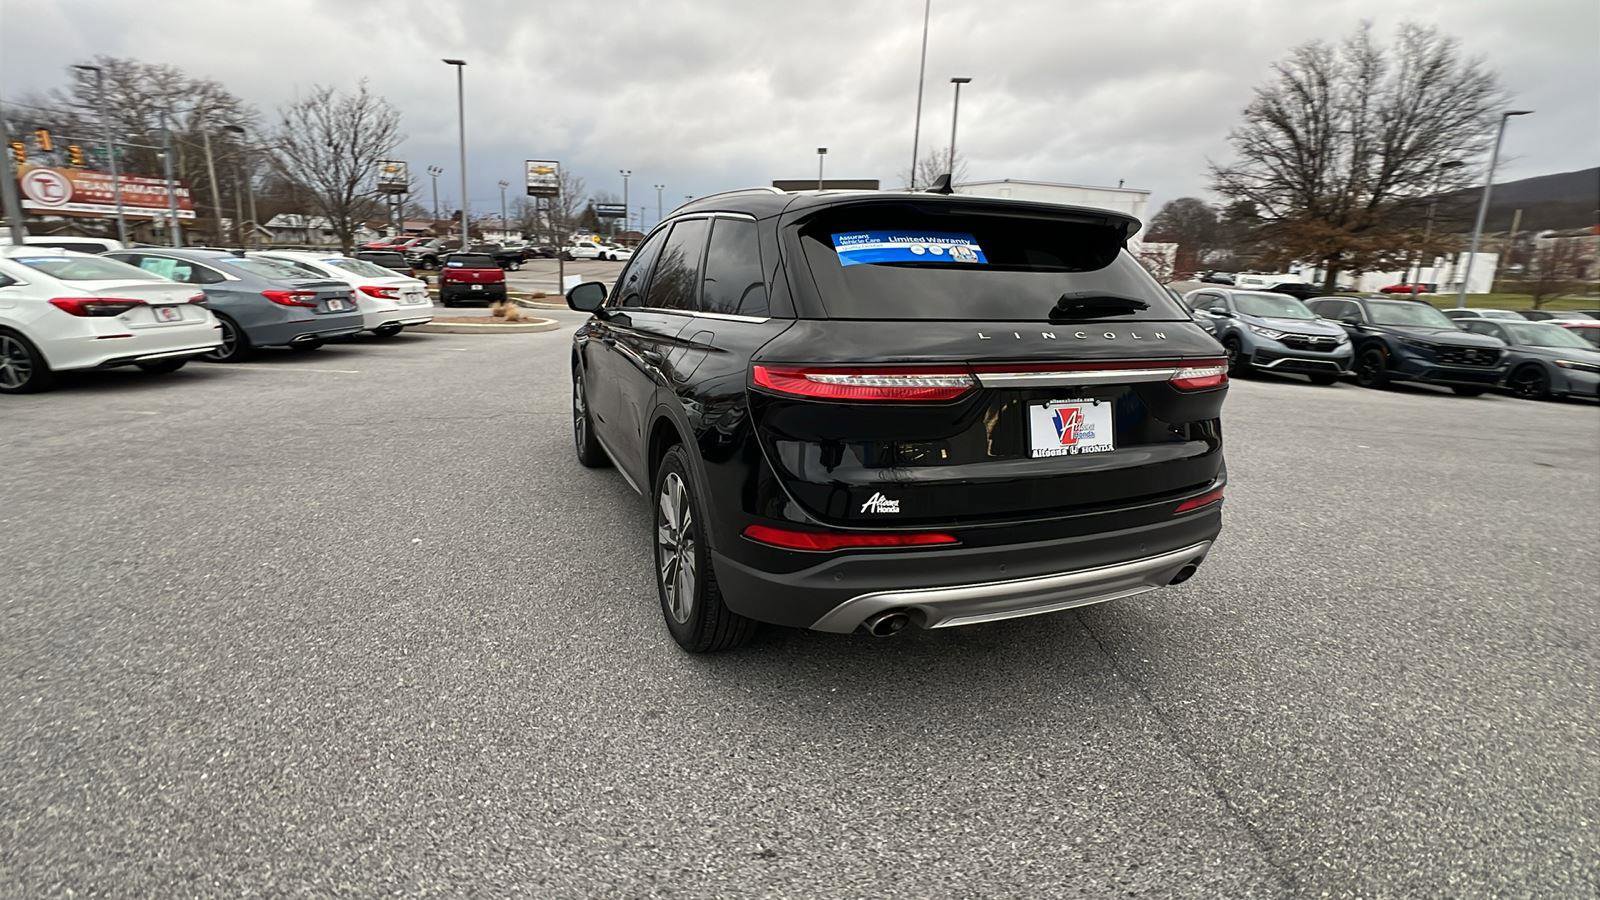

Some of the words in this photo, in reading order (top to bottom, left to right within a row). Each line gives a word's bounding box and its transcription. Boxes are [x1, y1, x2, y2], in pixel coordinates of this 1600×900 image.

[926, 237, 971, 246] Warranty
[977, 331, 1167, 340] LINCOLN
[1032, 448, 1068, 458] Altoona
[1081, 444, 1114, 453] HONDA
